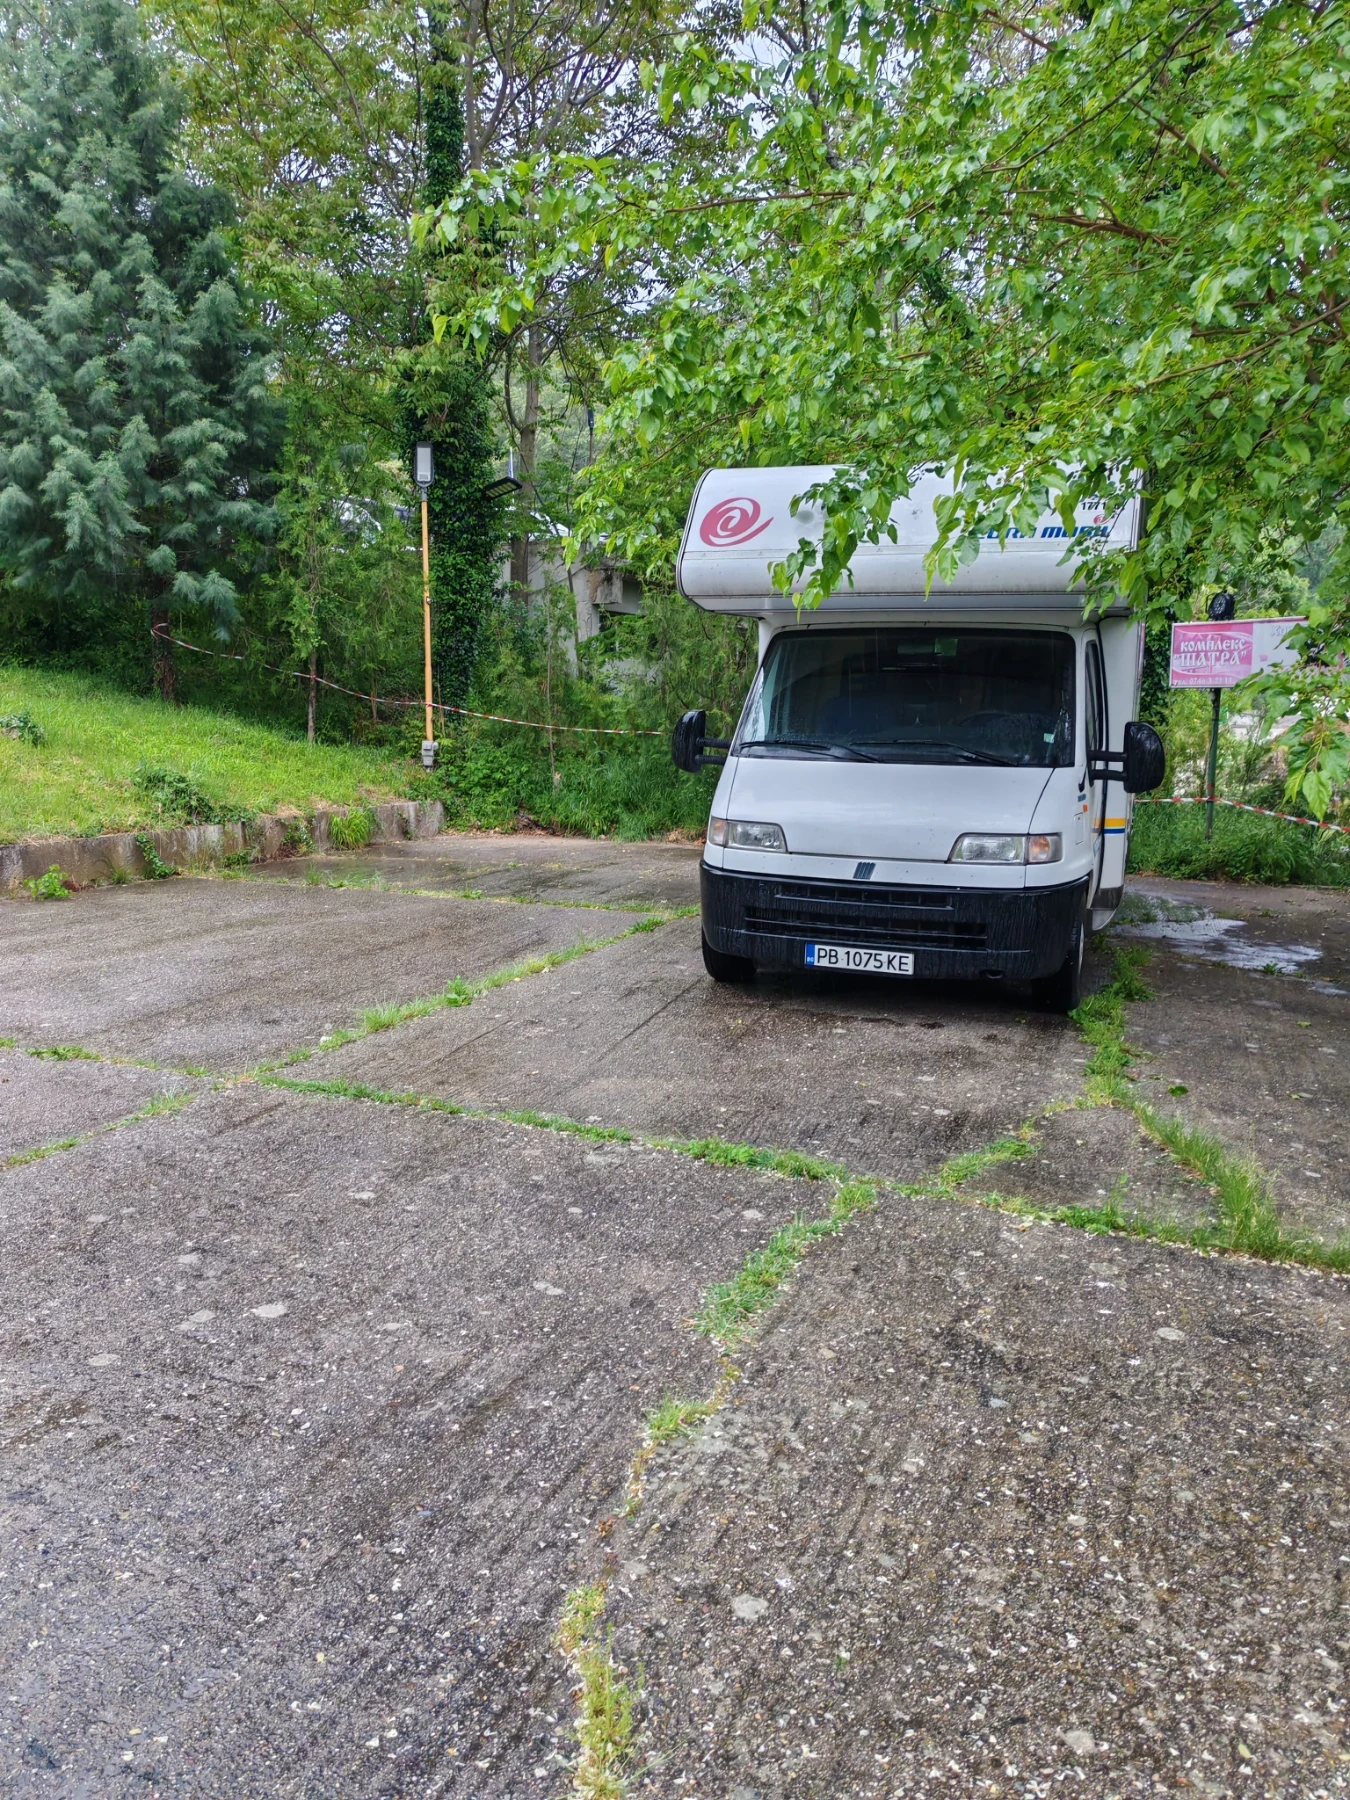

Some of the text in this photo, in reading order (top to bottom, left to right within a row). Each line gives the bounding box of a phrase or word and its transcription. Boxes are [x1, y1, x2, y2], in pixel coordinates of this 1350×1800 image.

[977, 527, 1038, 539] UR
[1180, 638, 1246, 653] КОМПЛЕКС
[816, 947, 910, 973] PB 1075 KE
